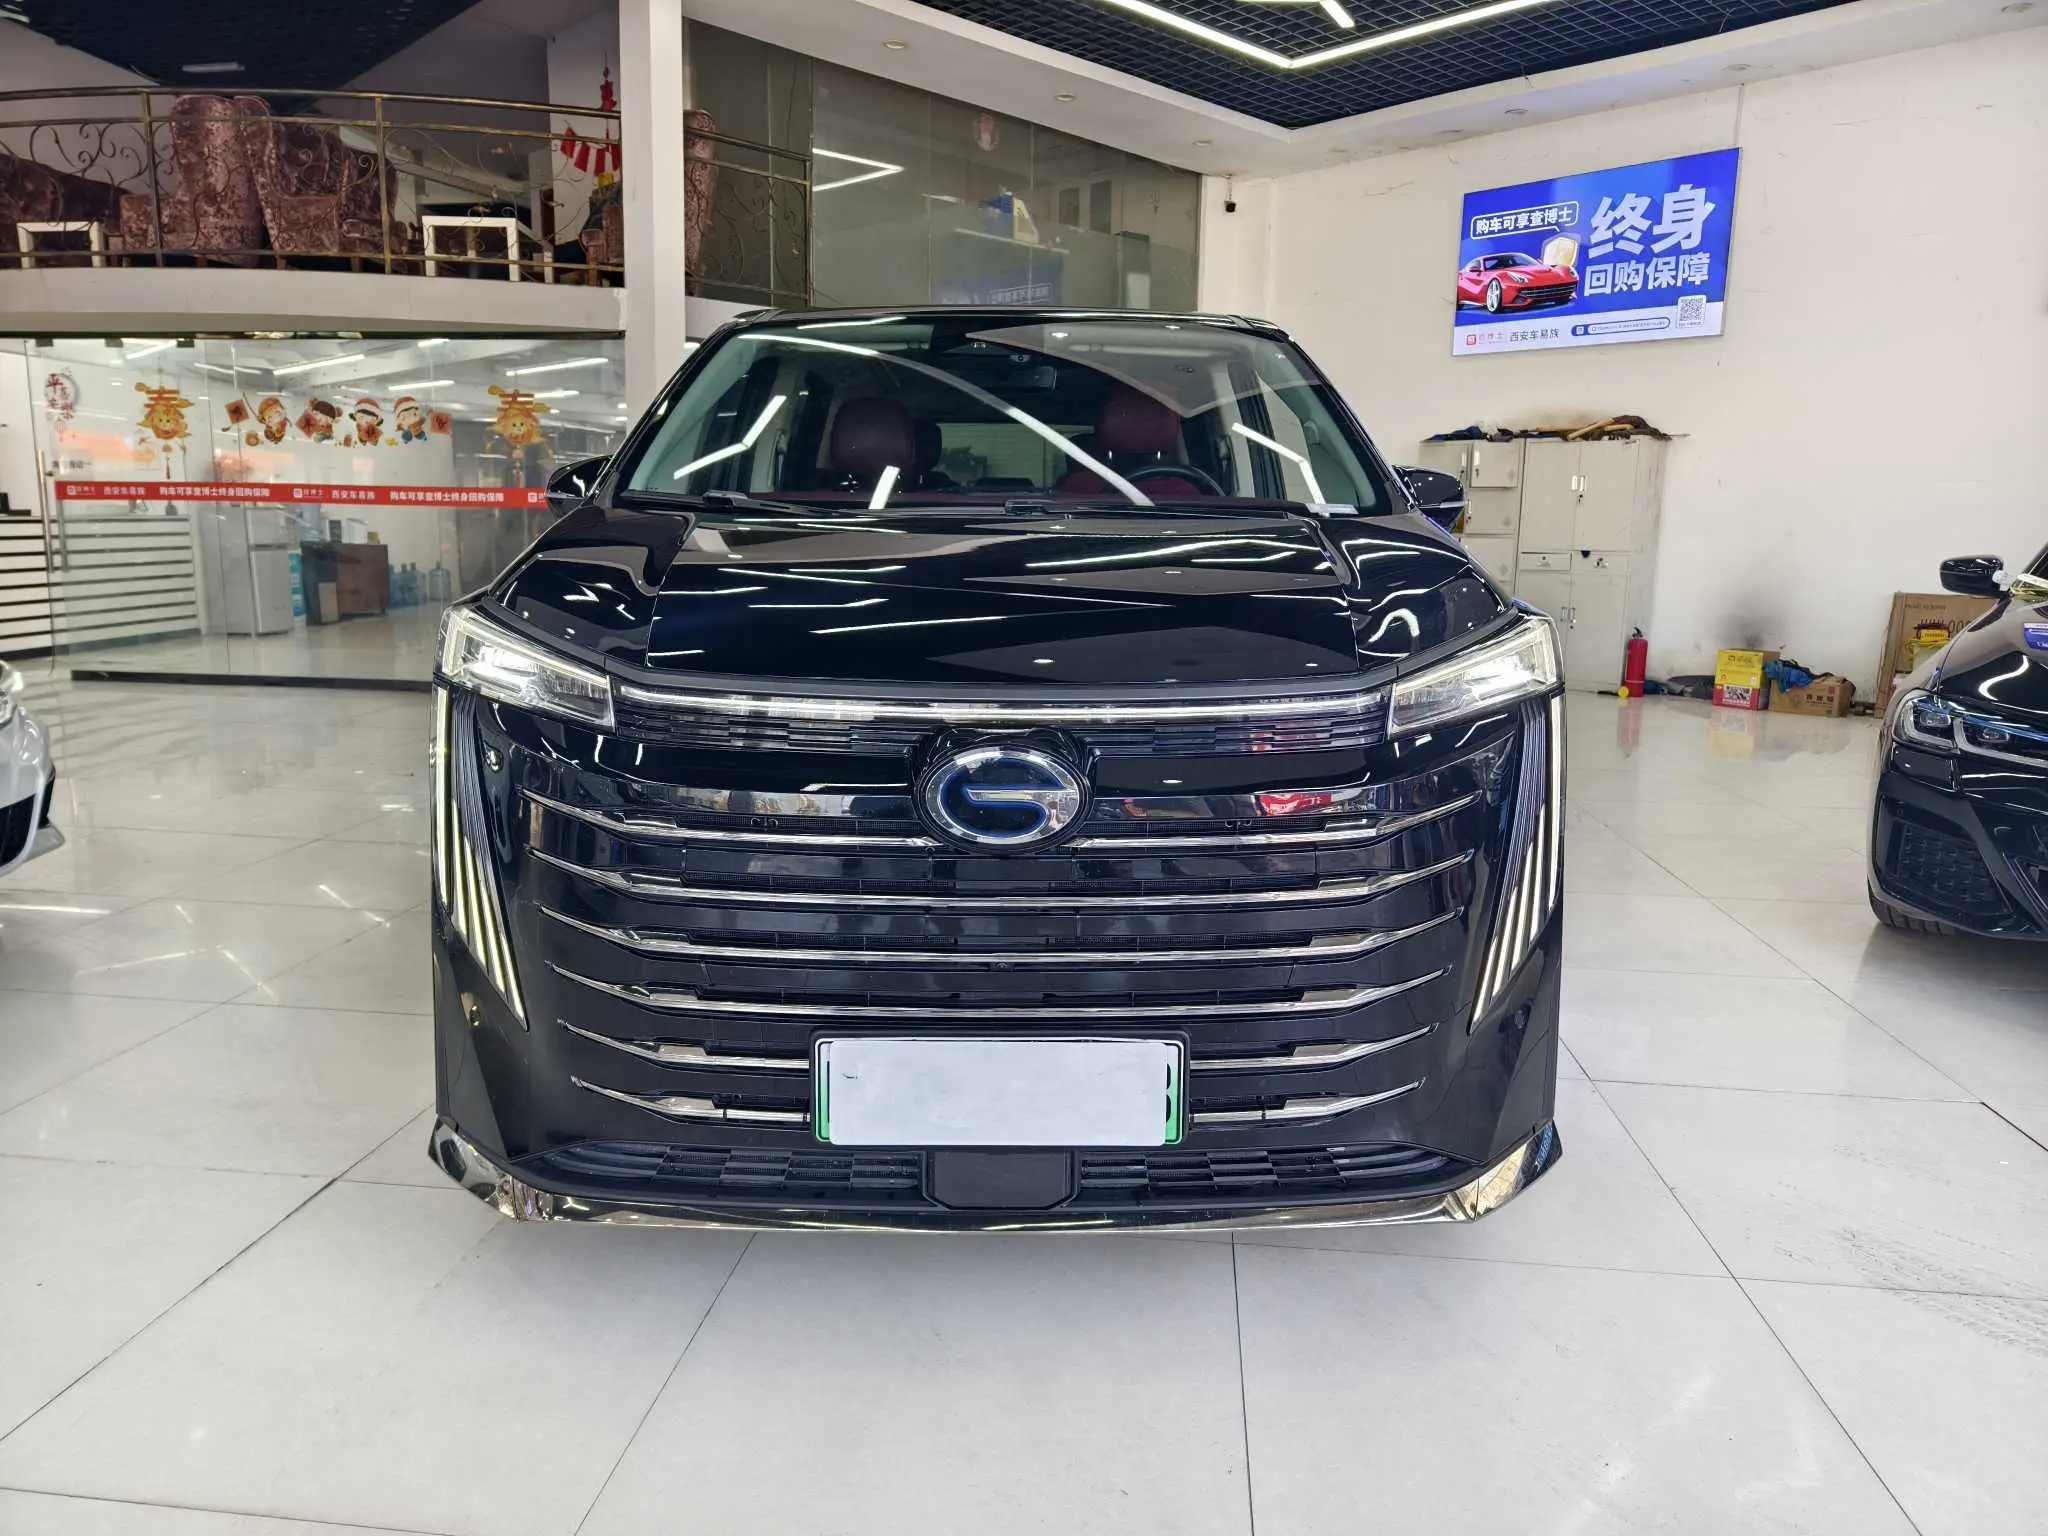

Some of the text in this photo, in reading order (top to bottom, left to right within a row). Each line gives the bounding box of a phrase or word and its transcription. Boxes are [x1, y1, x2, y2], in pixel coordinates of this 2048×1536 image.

[1476, 206, 1573, 235] 购车可享查博士
[1588, 184, 1716, 259] 终身
[1584, 251, 1711, 297] 回购保障
